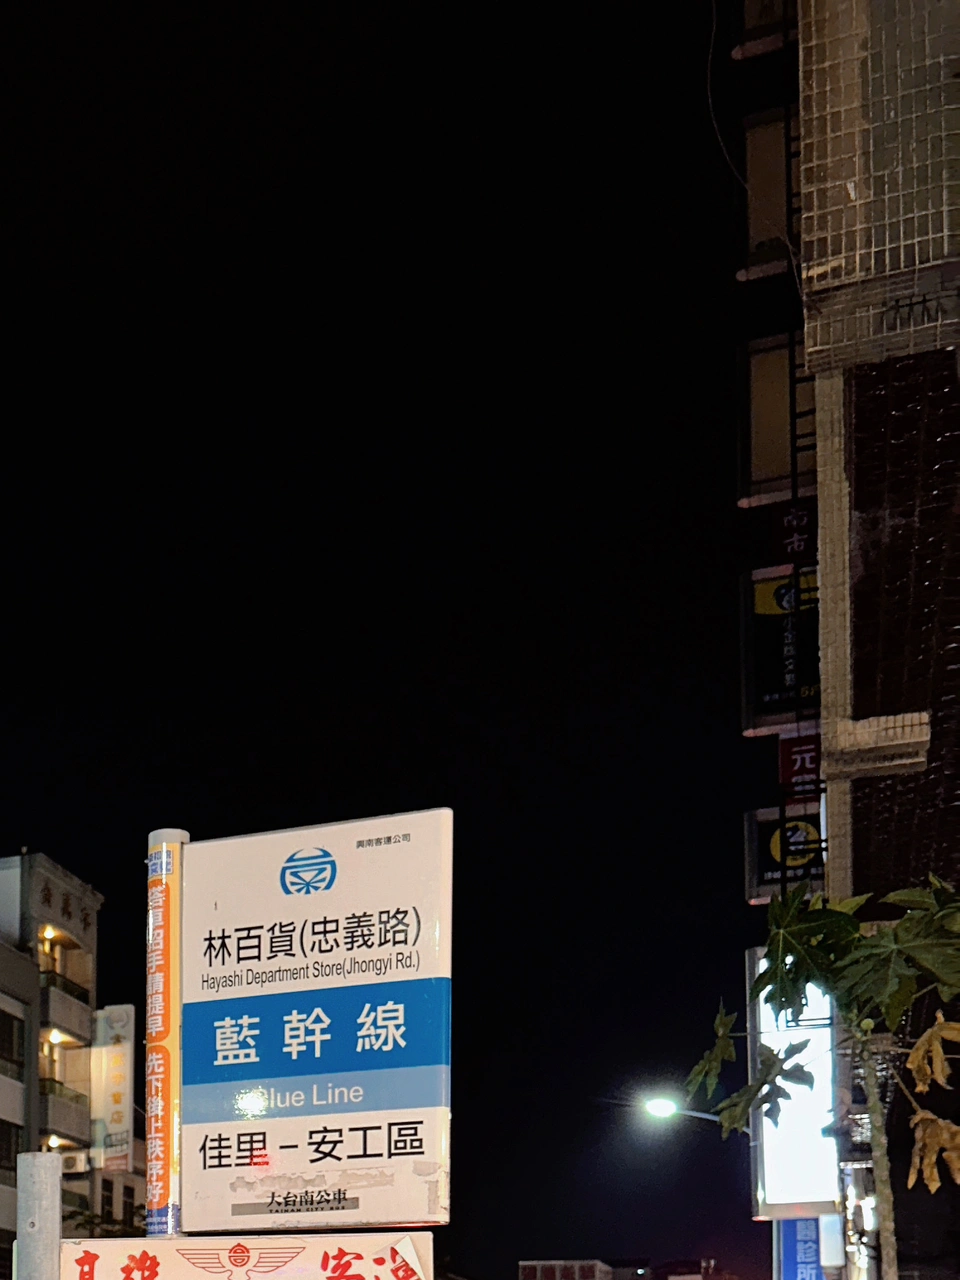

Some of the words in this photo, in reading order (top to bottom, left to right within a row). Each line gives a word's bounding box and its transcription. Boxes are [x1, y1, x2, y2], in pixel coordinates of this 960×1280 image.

[356, 833, 411, 849] 興南客運公司
[202, 905, 422, 967] 林百貨(忠義路)
[201, 970, 243, 992] Hayashi
[245, 963, 310, 989] Department
[312, 955, 393, 981] Store(Jhongyi
[395, 950, 421, 972] Rd.)
[213, 1000, 408, 1066] 藍幹線
[312, 1083, 364, 1106] Line
[267, 1188, 348, 1208] 大台南公車
